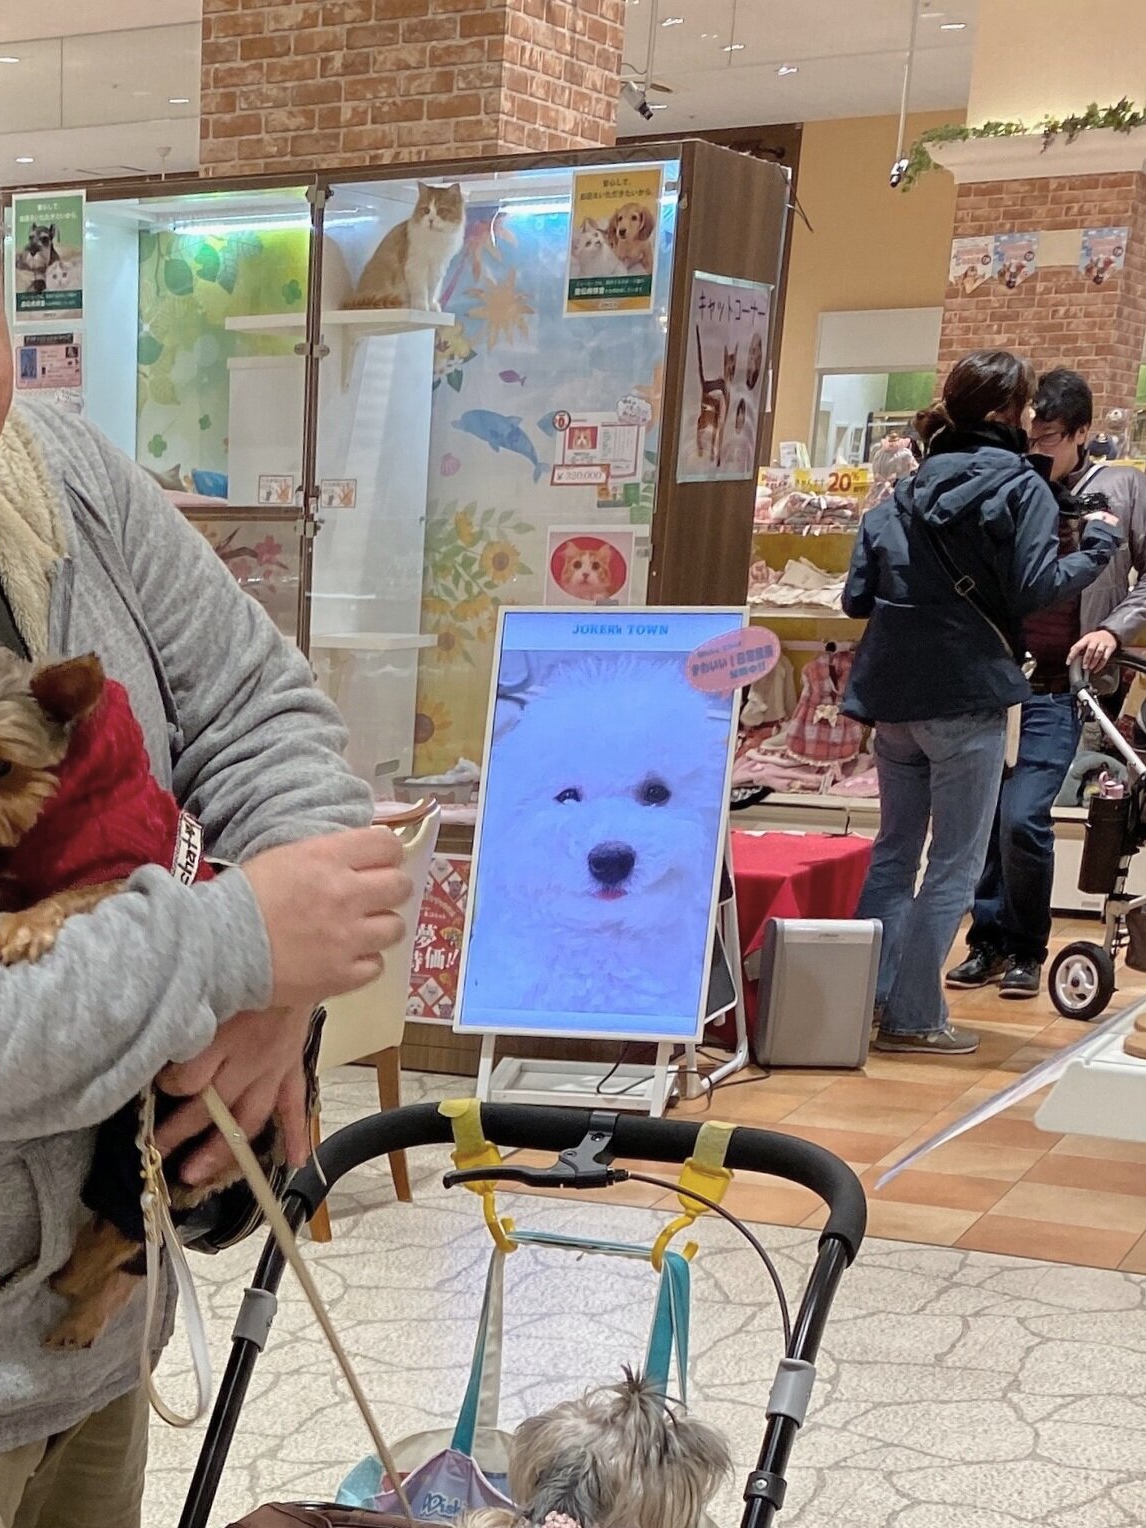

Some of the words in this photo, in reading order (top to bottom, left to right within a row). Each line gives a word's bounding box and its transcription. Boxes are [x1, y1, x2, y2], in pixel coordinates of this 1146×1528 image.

[698, 291, 766, 326] キャットコーナー
[627, 624, 669, 635] TOWN
